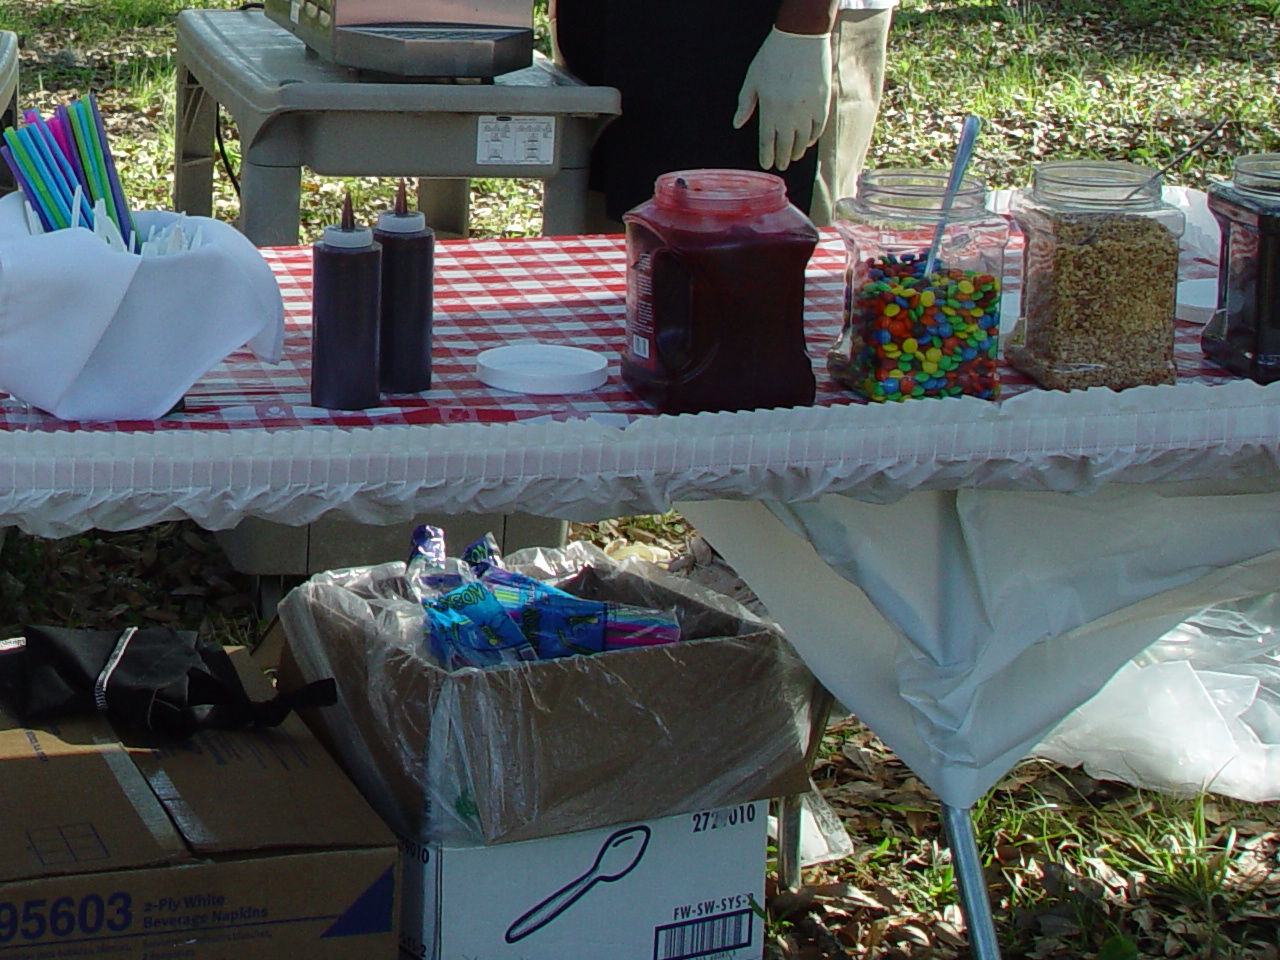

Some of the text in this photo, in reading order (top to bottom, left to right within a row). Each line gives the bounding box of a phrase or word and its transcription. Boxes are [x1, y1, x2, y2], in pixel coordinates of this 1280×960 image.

[692, 803, 756, 833] 272010
[144, 896, 180, 913] 2-Ply
[184, 894, 225, 909] White
[143, 906, 269, 929] Beverage Napkins
